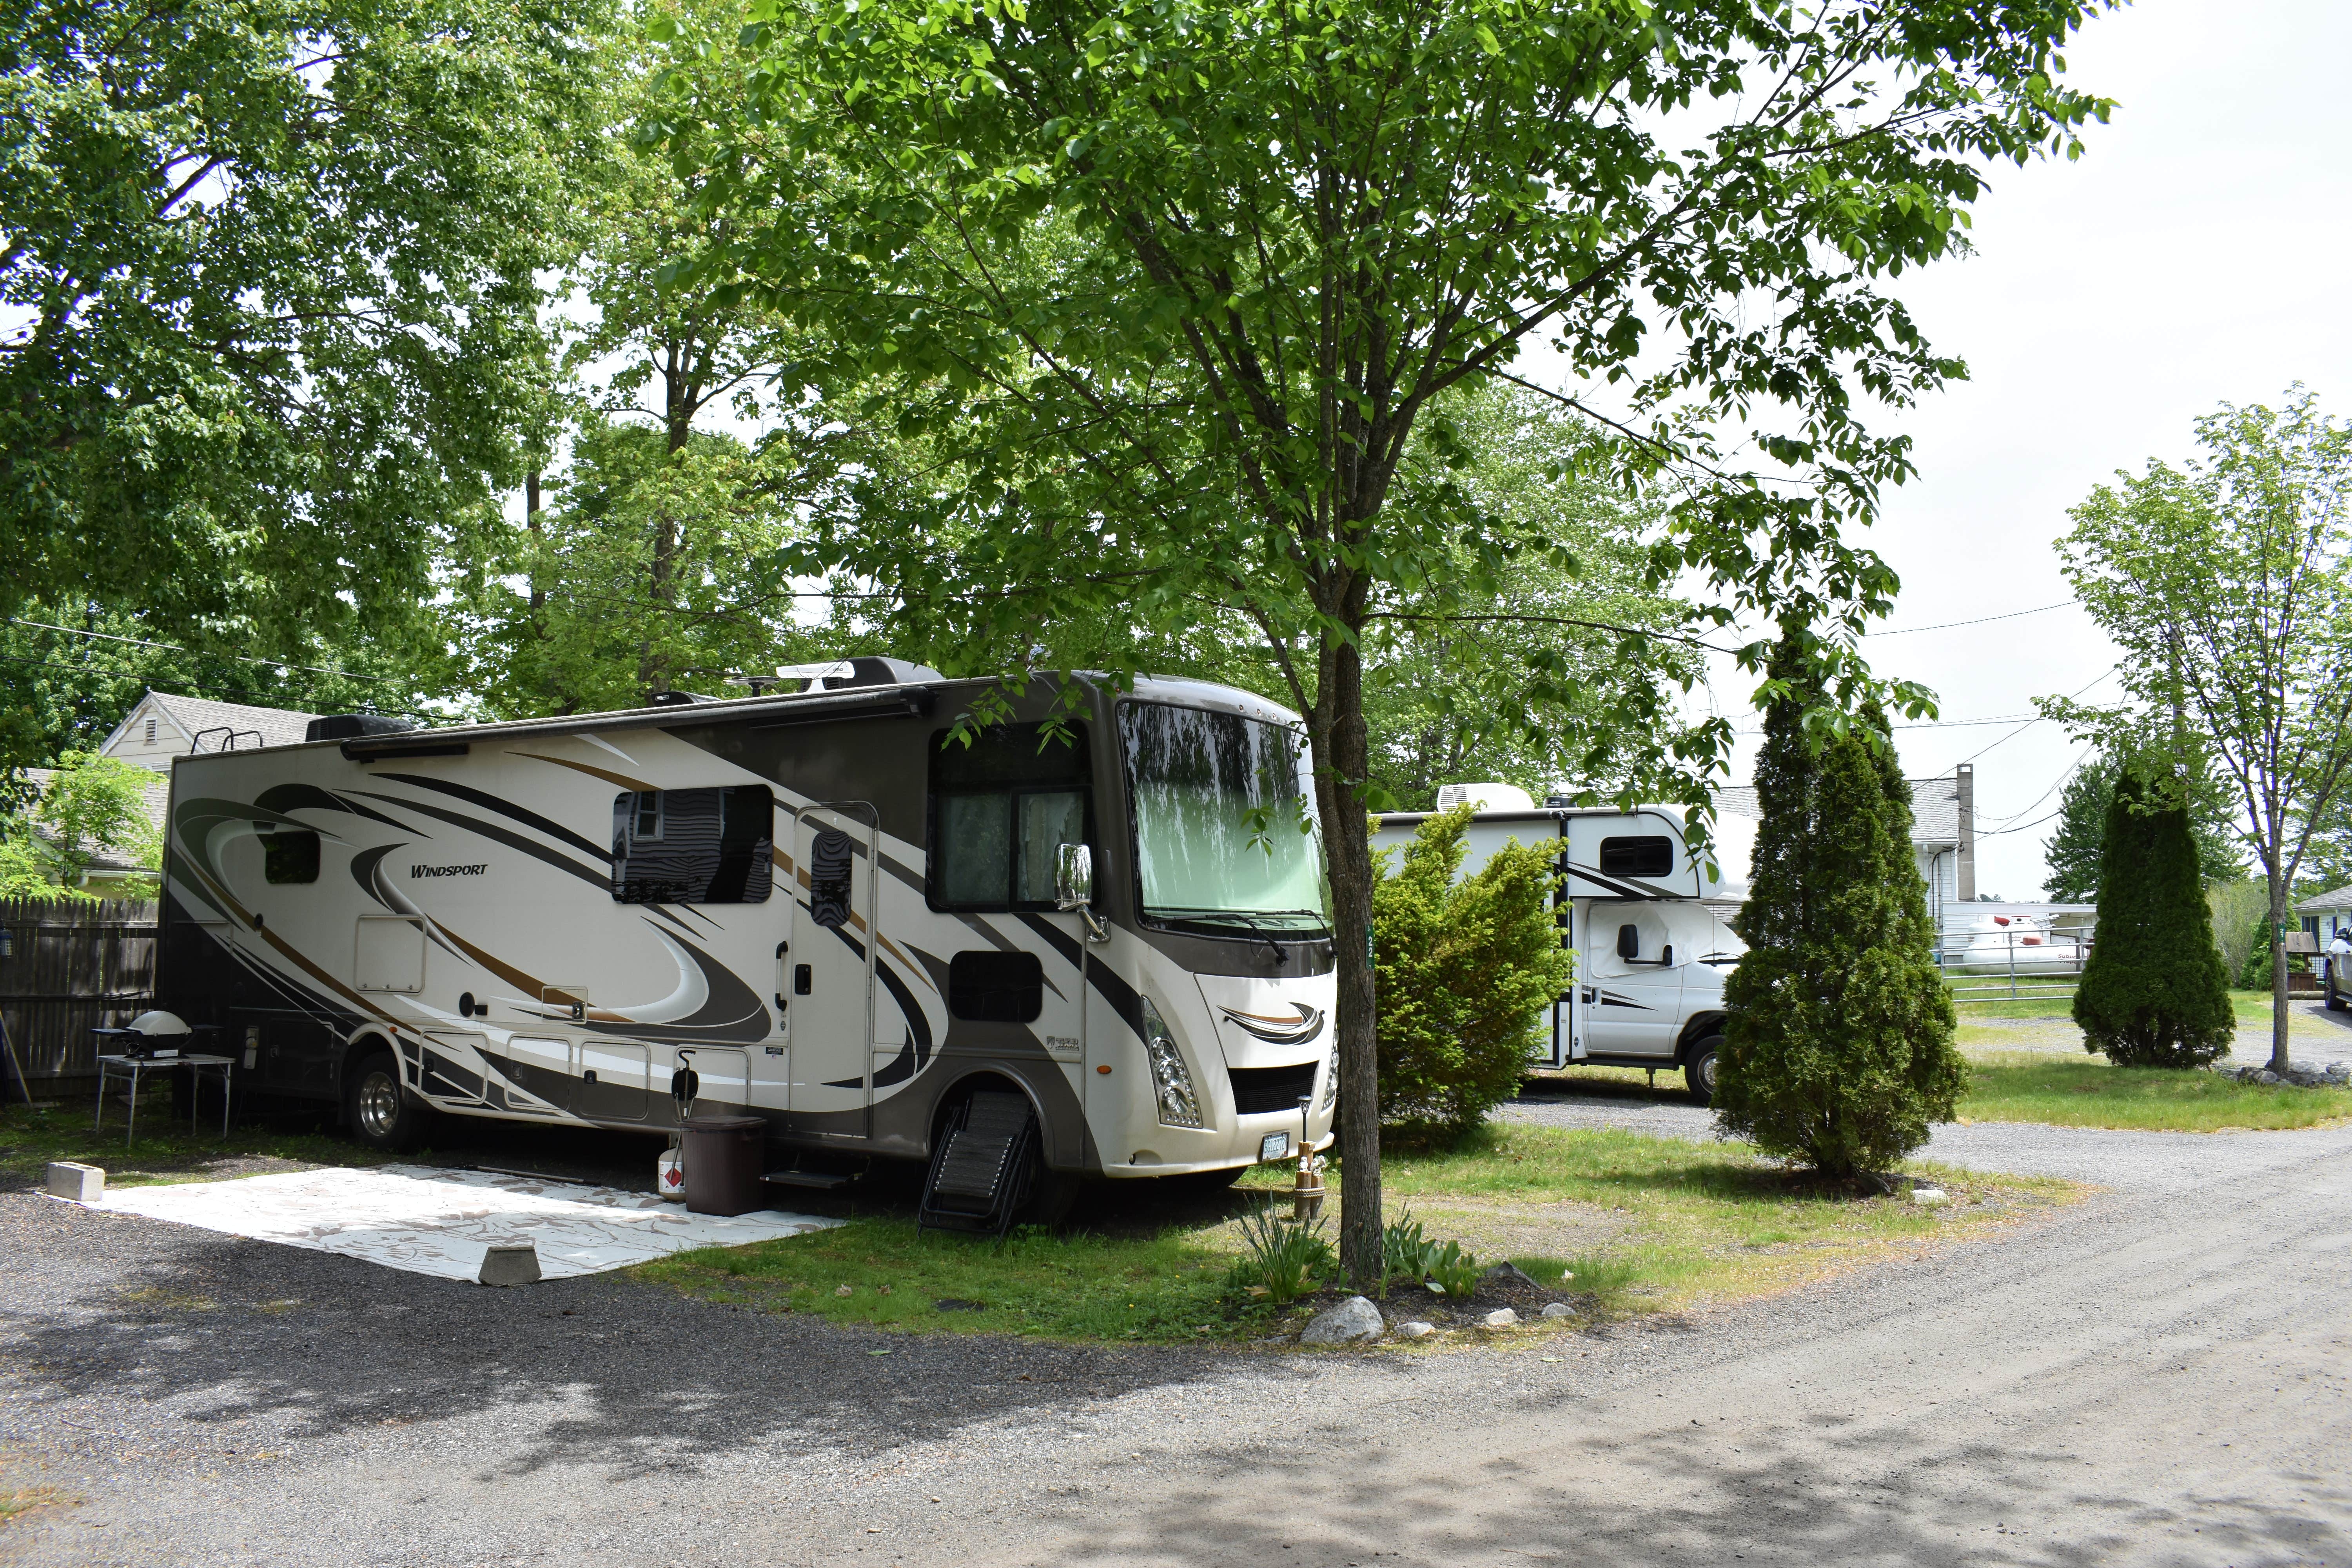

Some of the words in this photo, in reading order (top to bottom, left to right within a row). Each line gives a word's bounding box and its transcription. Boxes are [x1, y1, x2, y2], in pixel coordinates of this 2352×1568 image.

[412, 864, 488, 878] WINDSPORT
[2280, 928, 2283, 938] 21
[1368, 936, 1373, 957] 22
